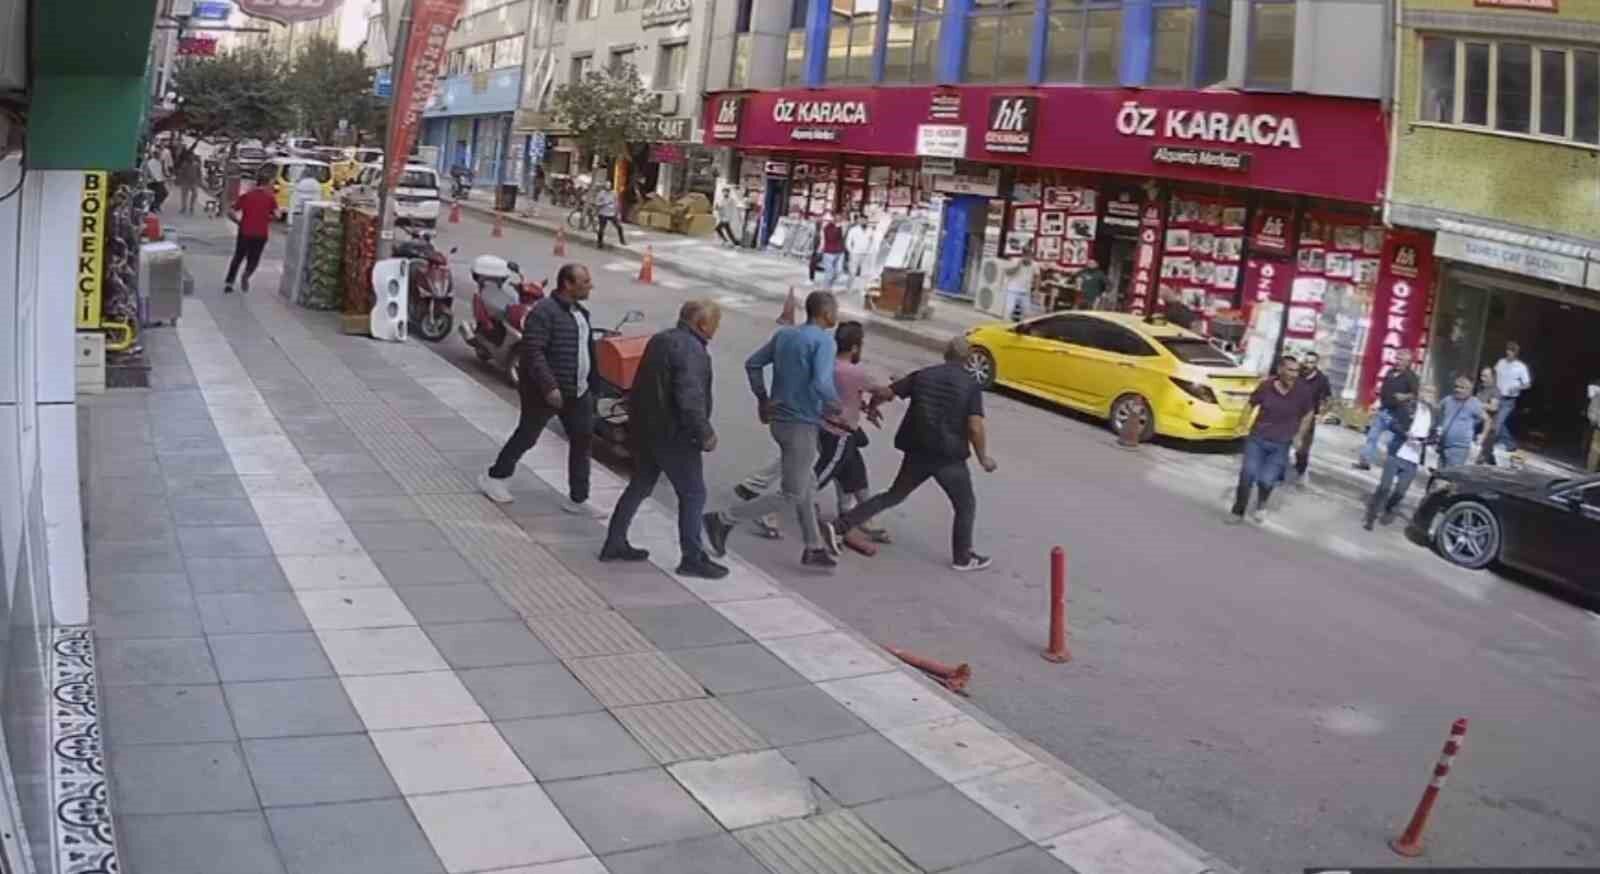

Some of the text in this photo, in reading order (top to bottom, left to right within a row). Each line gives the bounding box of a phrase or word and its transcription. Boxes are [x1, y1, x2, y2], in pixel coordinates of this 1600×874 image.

[773, 98, 867, 124] ÖZ KARACA
[992, 98, 1028, 130] hk
[1116, 100, 1301, 149] ÖZ KARACA
[79, 174, 101, 322] BÖREKÇİ
